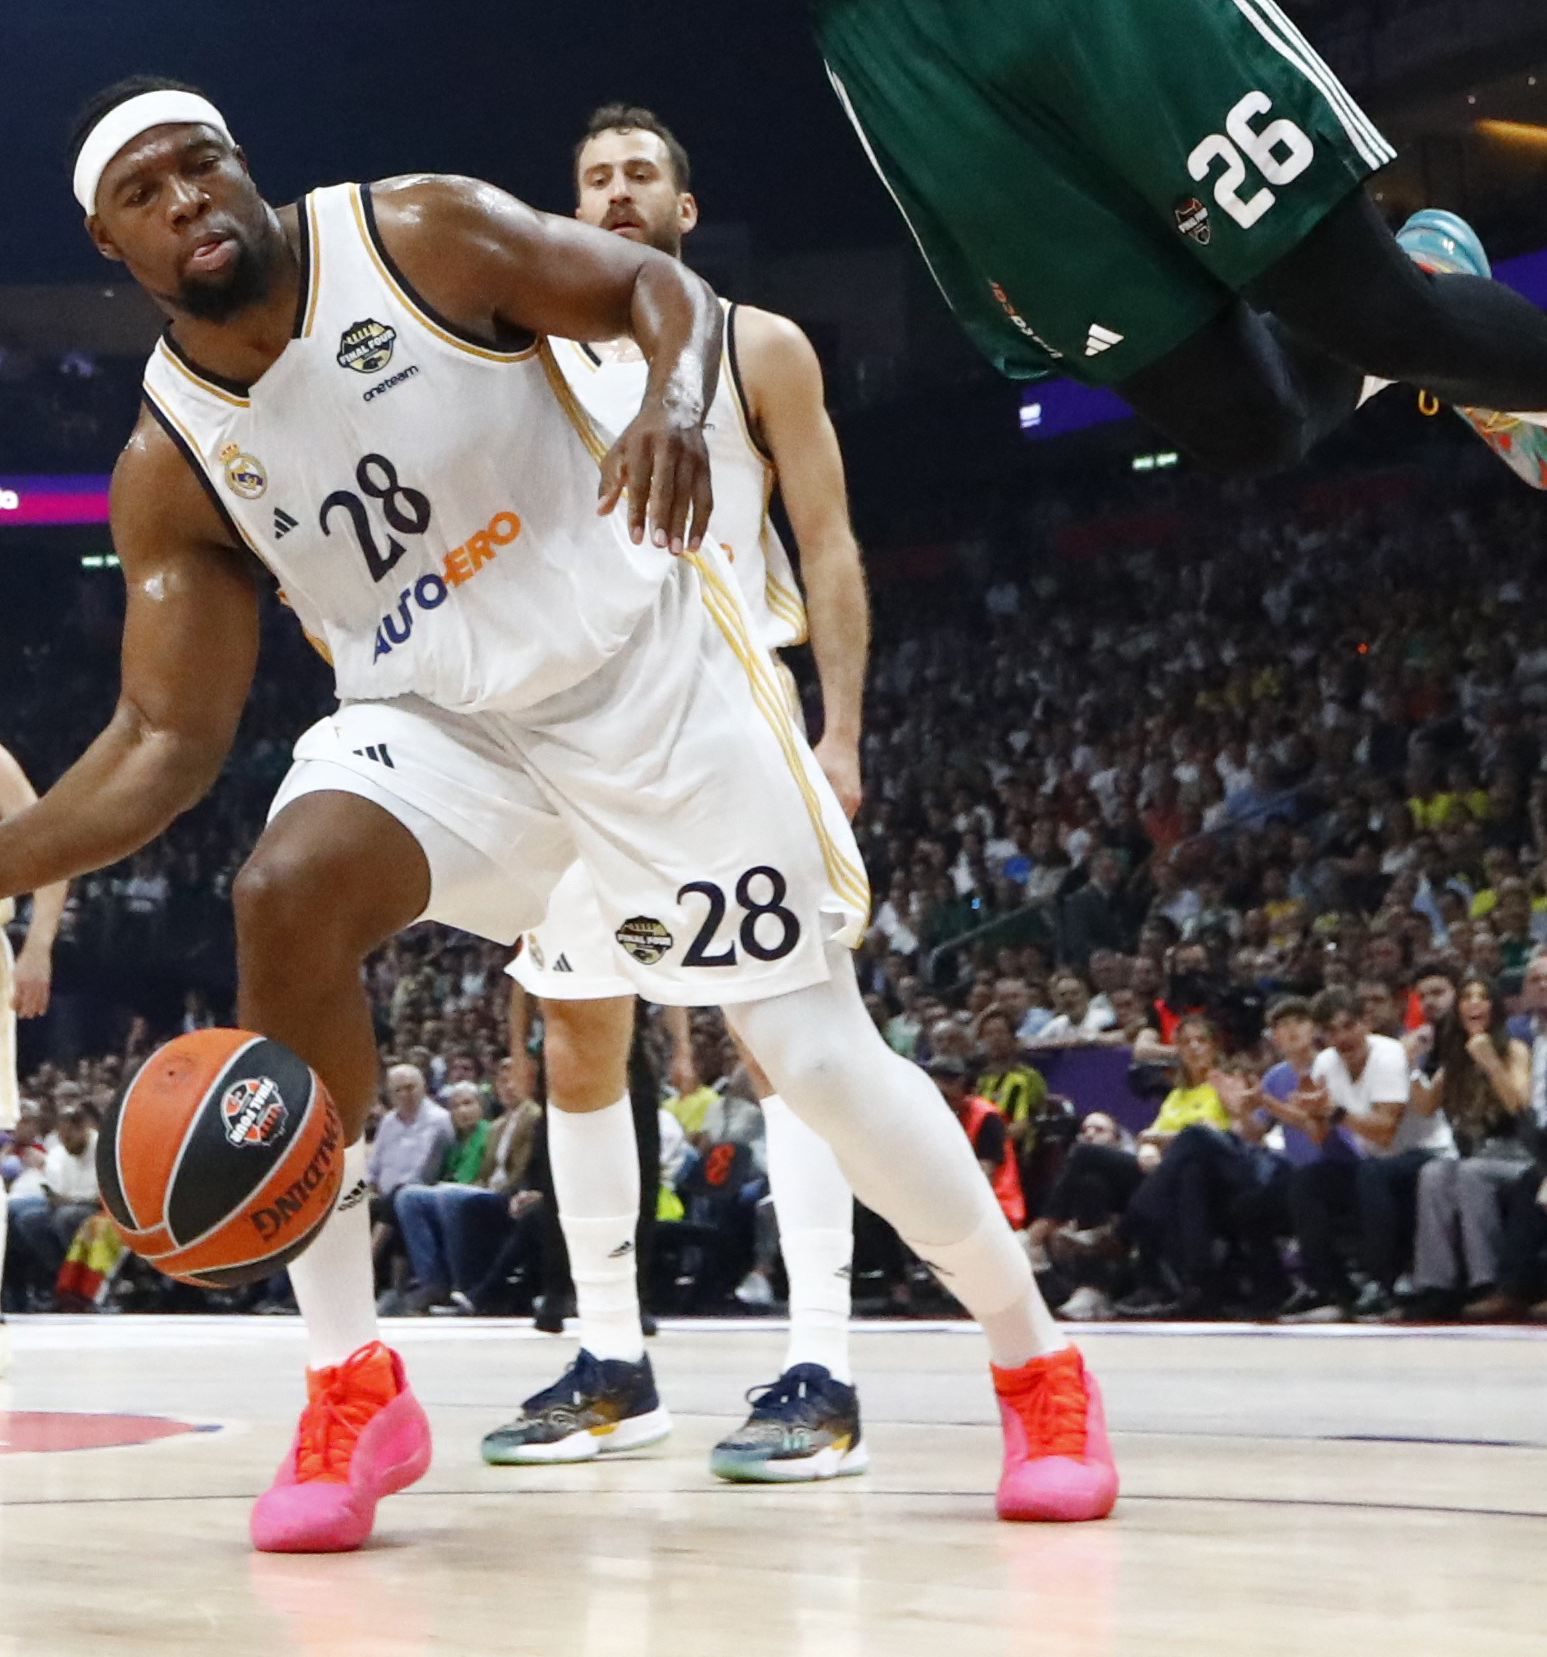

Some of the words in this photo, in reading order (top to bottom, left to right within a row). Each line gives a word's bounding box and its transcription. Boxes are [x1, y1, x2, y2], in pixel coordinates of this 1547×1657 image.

[1187, 90, 1314, 230] 26
[339, 345, 369, 364] FINAL
[368, 329, 395, 349] FOUR
[363, 365, 419, 402] oneteam
[319, 453, 431, 583] 28
[676, 865, 802, 968] 28
[249, 1078, 274, 1110] FINAL
[229, 1108, 258, 1143] FOUR
